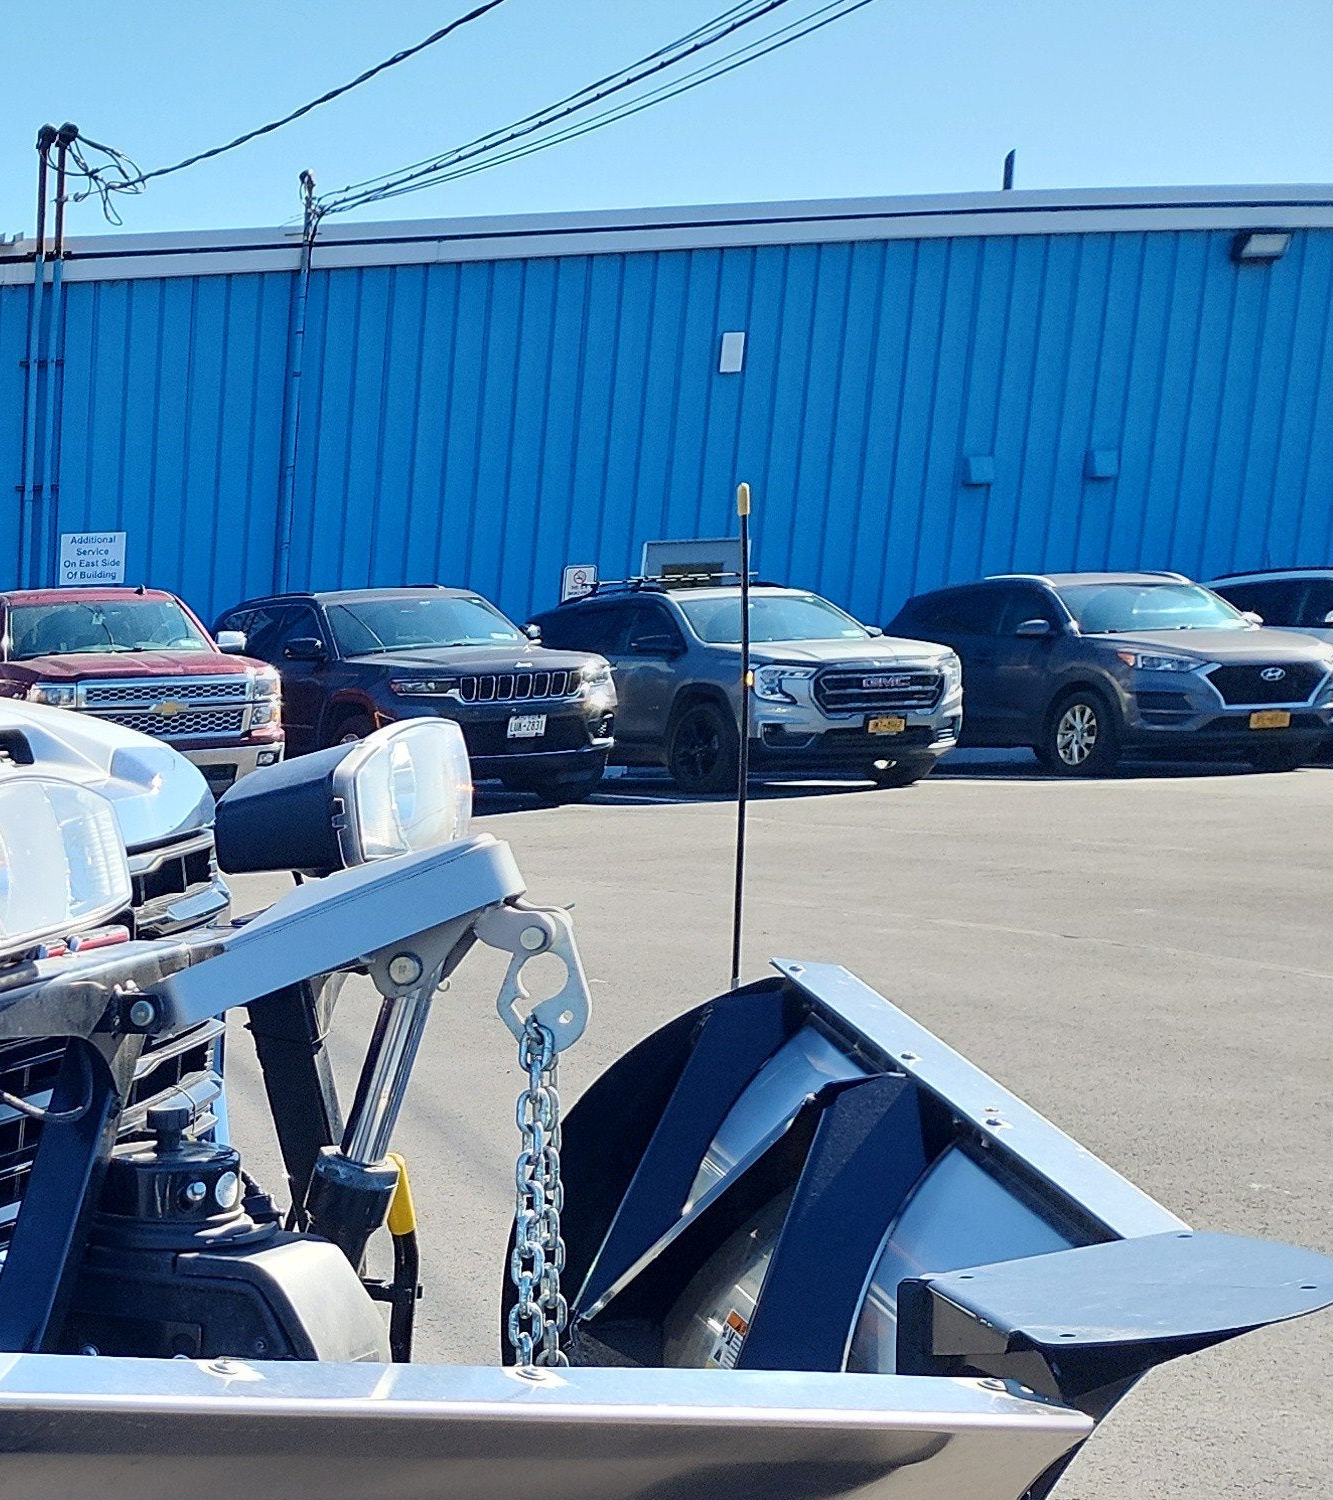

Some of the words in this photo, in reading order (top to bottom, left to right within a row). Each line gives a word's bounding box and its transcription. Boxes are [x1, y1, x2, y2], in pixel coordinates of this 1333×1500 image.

[70, 536, 116, 544] Additional
[76, 548, 109, 556] Service
[63, 560, 76, 568] On
[79, 559, 100, 568] East
[101, 559, 121, 567] Side
[66, 571, 77, 580] Of
[79, 571, 117, 580] Building
[862, 676, 911, 688] GMC
